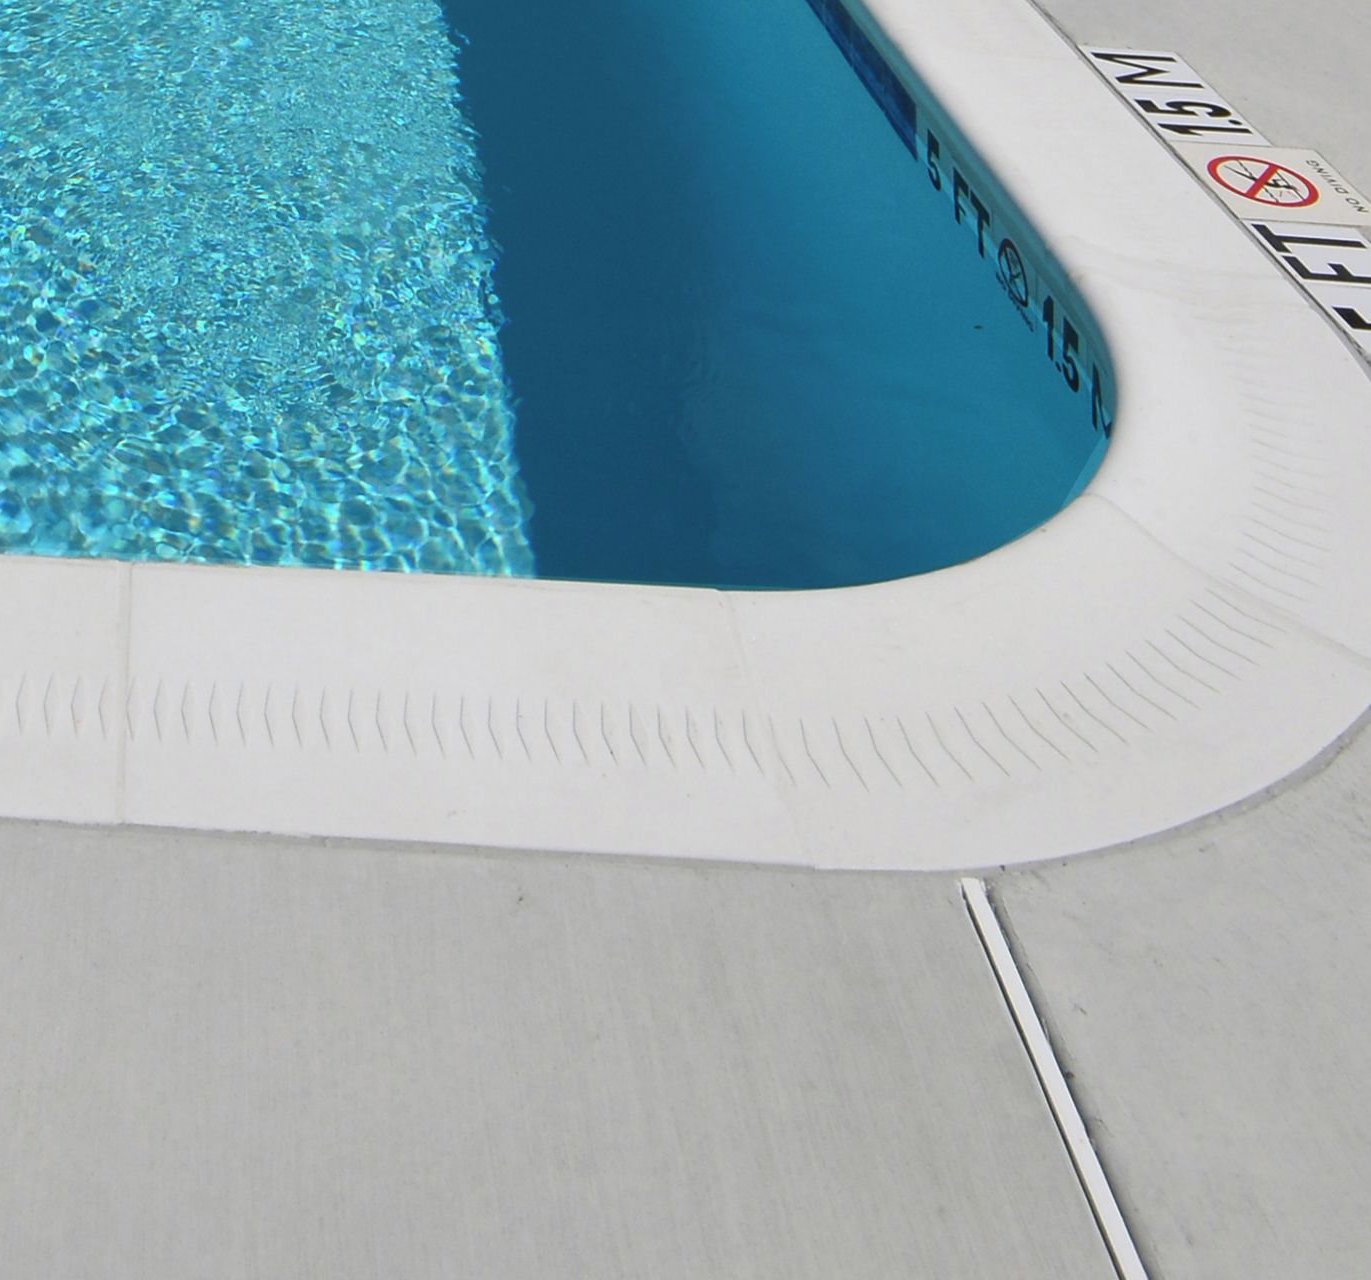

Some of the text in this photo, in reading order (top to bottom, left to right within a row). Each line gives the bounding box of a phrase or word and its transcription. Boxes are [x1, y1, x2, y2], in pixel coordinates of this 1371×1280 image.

[1090, 51, 1254, 137] 1.5 M
[927, 128, 990, 258] 5 FT
[1304, 159, 1371, 215] NO DIVING
[1042, 295, 1080, 393] 1.5
